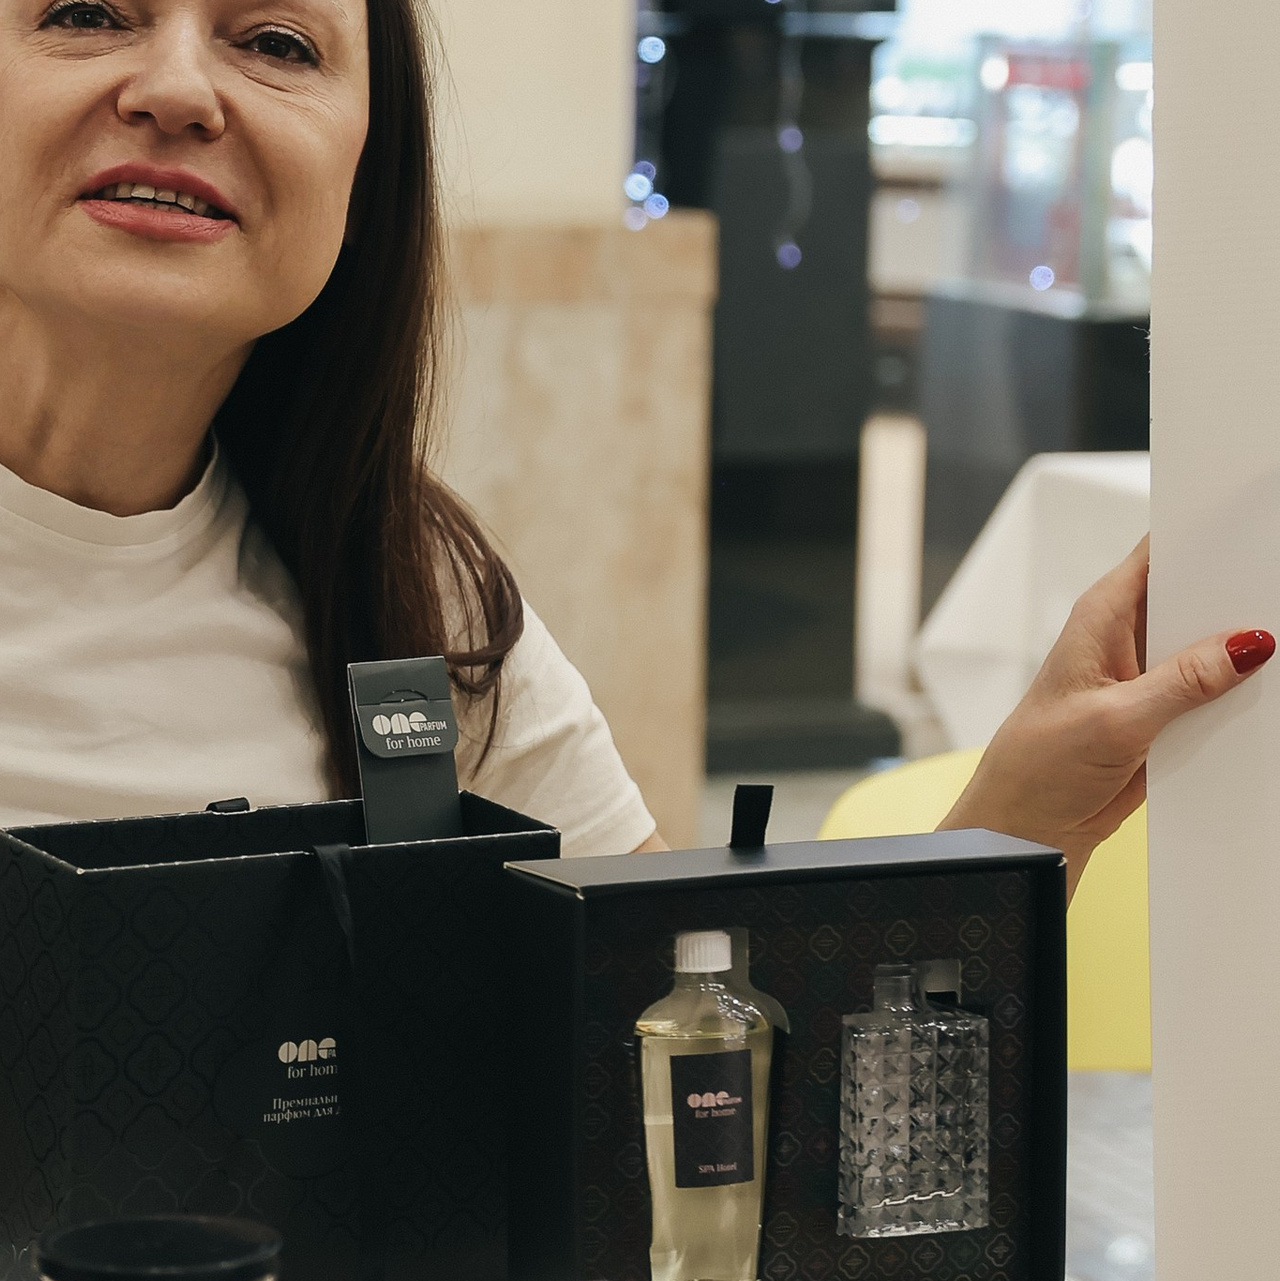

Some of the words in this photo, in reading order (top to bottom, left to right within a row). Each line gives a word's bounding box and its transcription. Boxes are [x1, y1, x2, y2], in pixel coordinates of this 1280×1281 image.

[419, 721, 448, 732] PARFUM
[386, 737, 404, 750] for
[406, 735, 442, 749] home
[287, 1066, 306, 1079] for
[263, 1109, 311, 1124] парфюм
[313, 1106, 334, 1118] для
